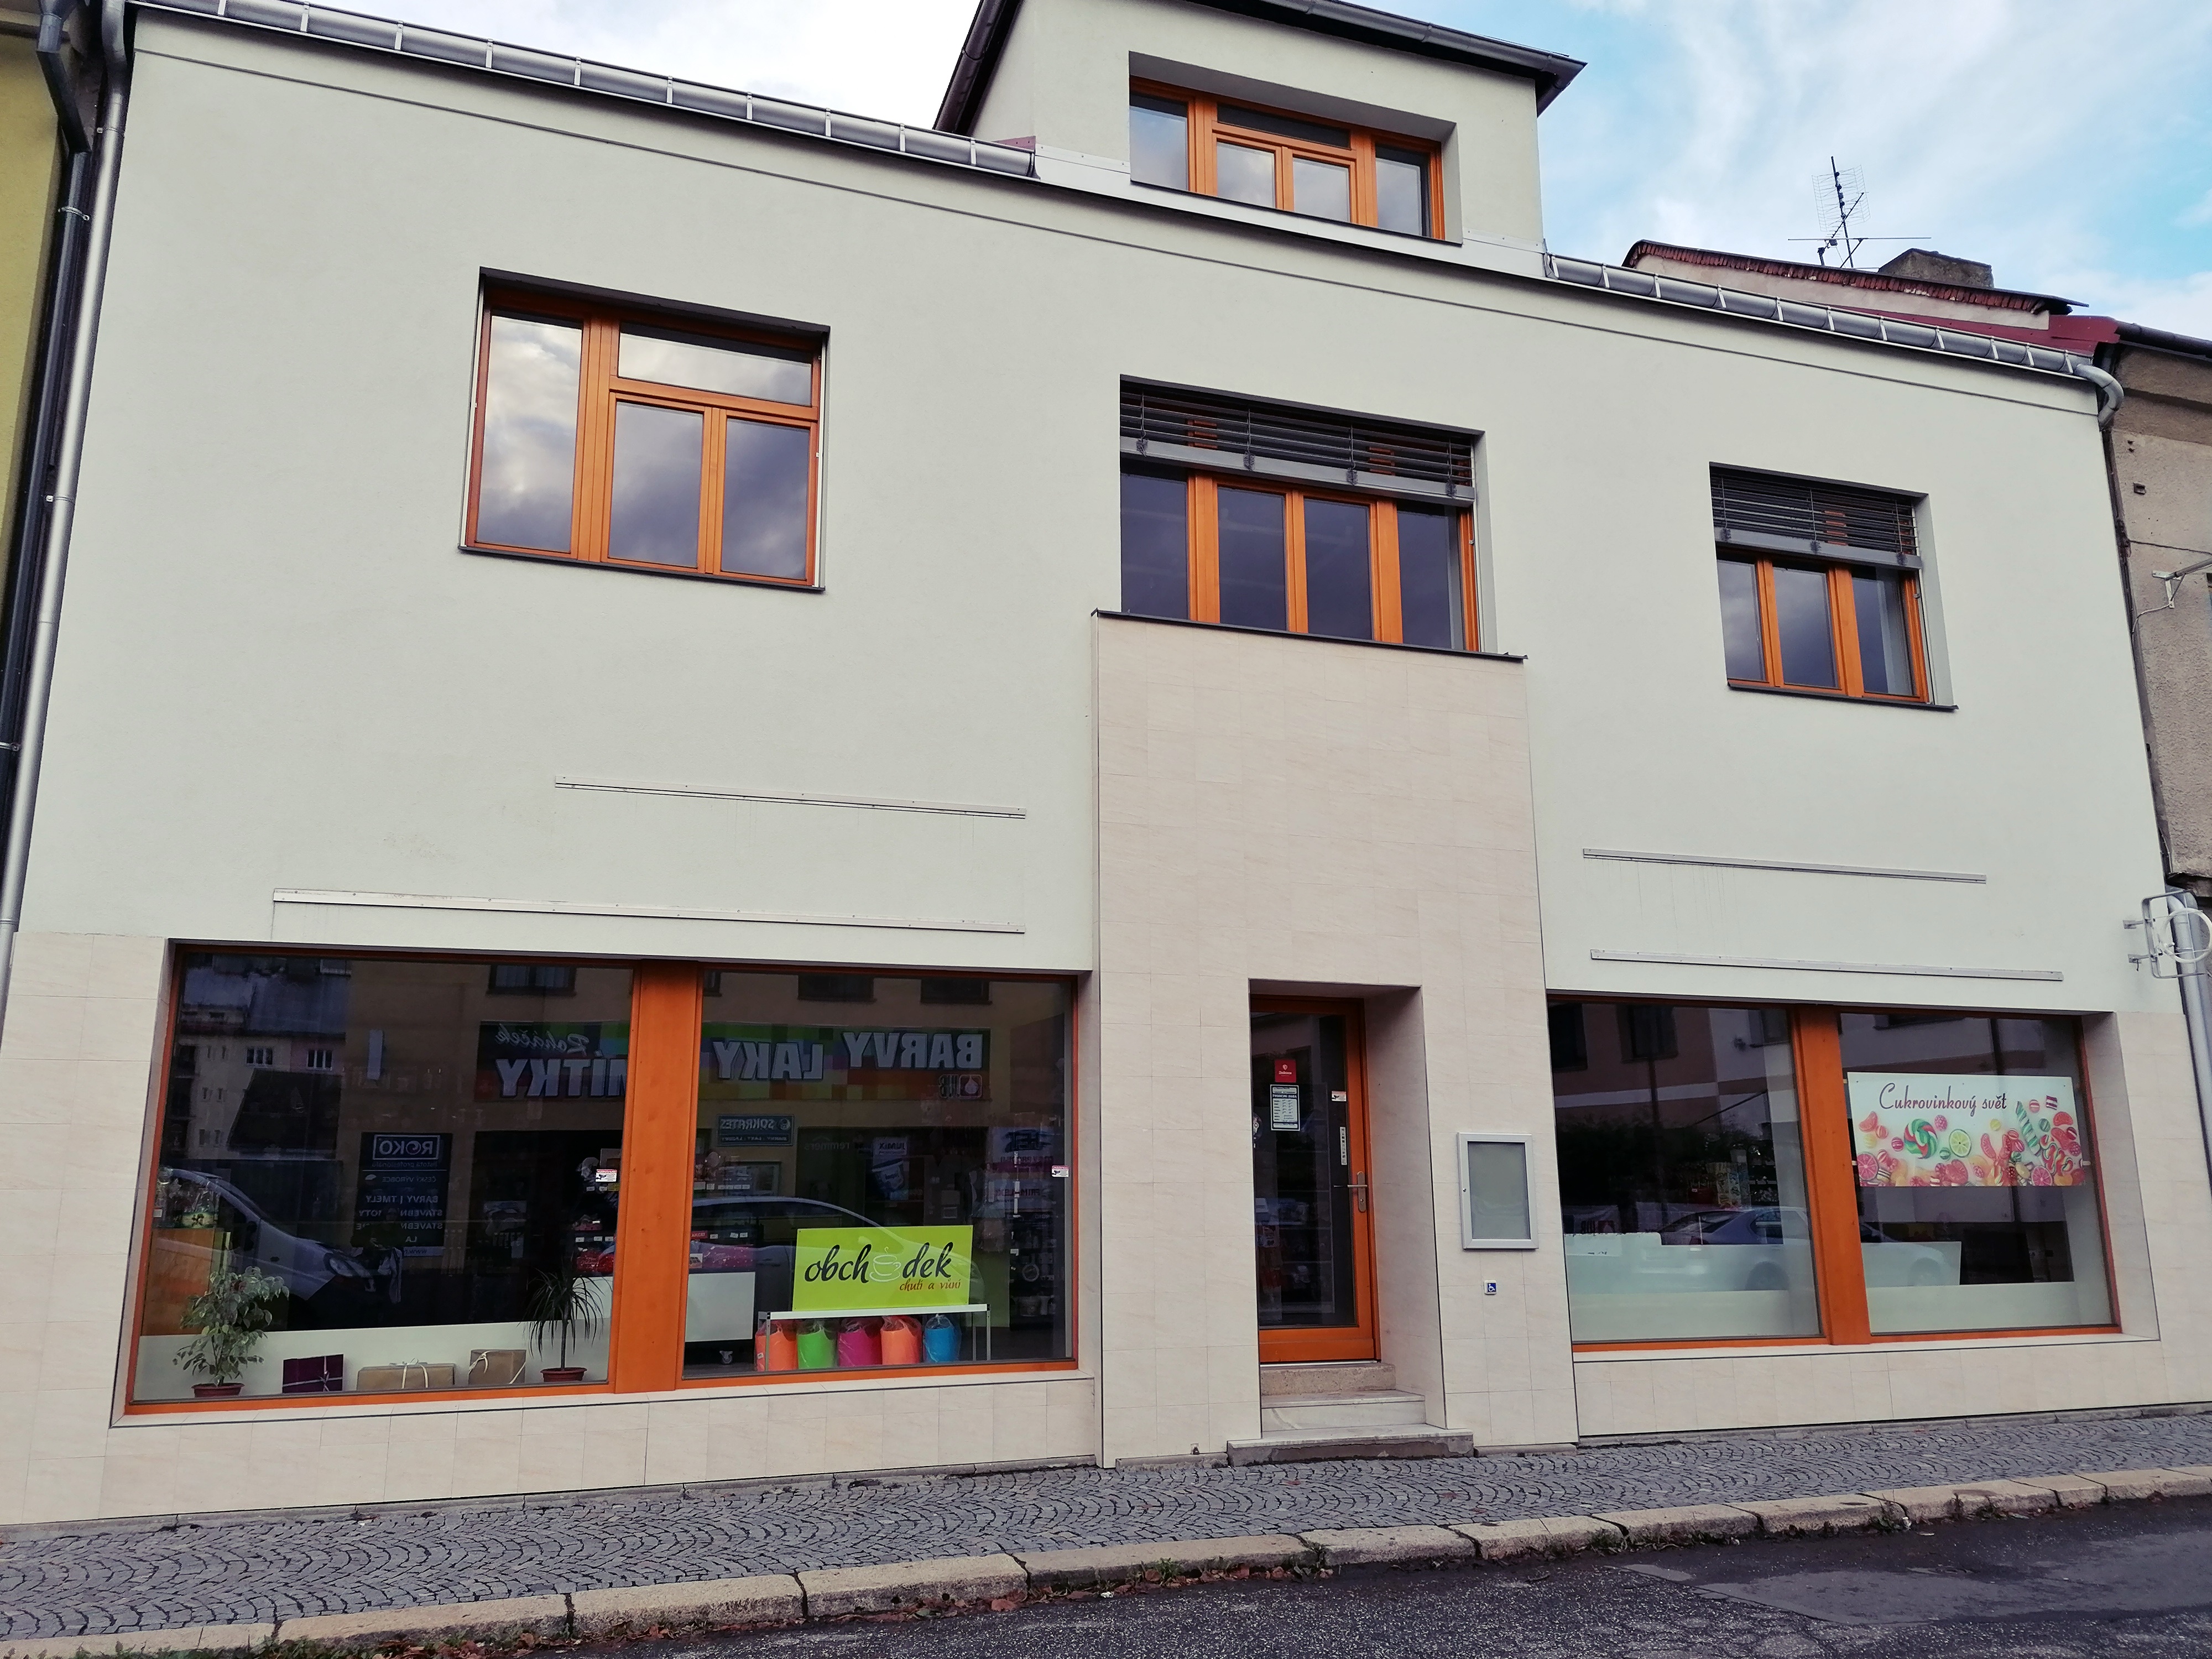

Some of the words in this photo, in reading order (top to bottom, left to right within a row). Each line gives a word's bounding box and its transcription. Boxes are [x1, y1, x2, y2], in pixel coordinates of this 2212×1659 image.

[1879, 1082, 1977, 1117] Cukrovinkový
[1981, 1093, 2007, 1109] svět
[940, 1278, 961, 1290] vůní
